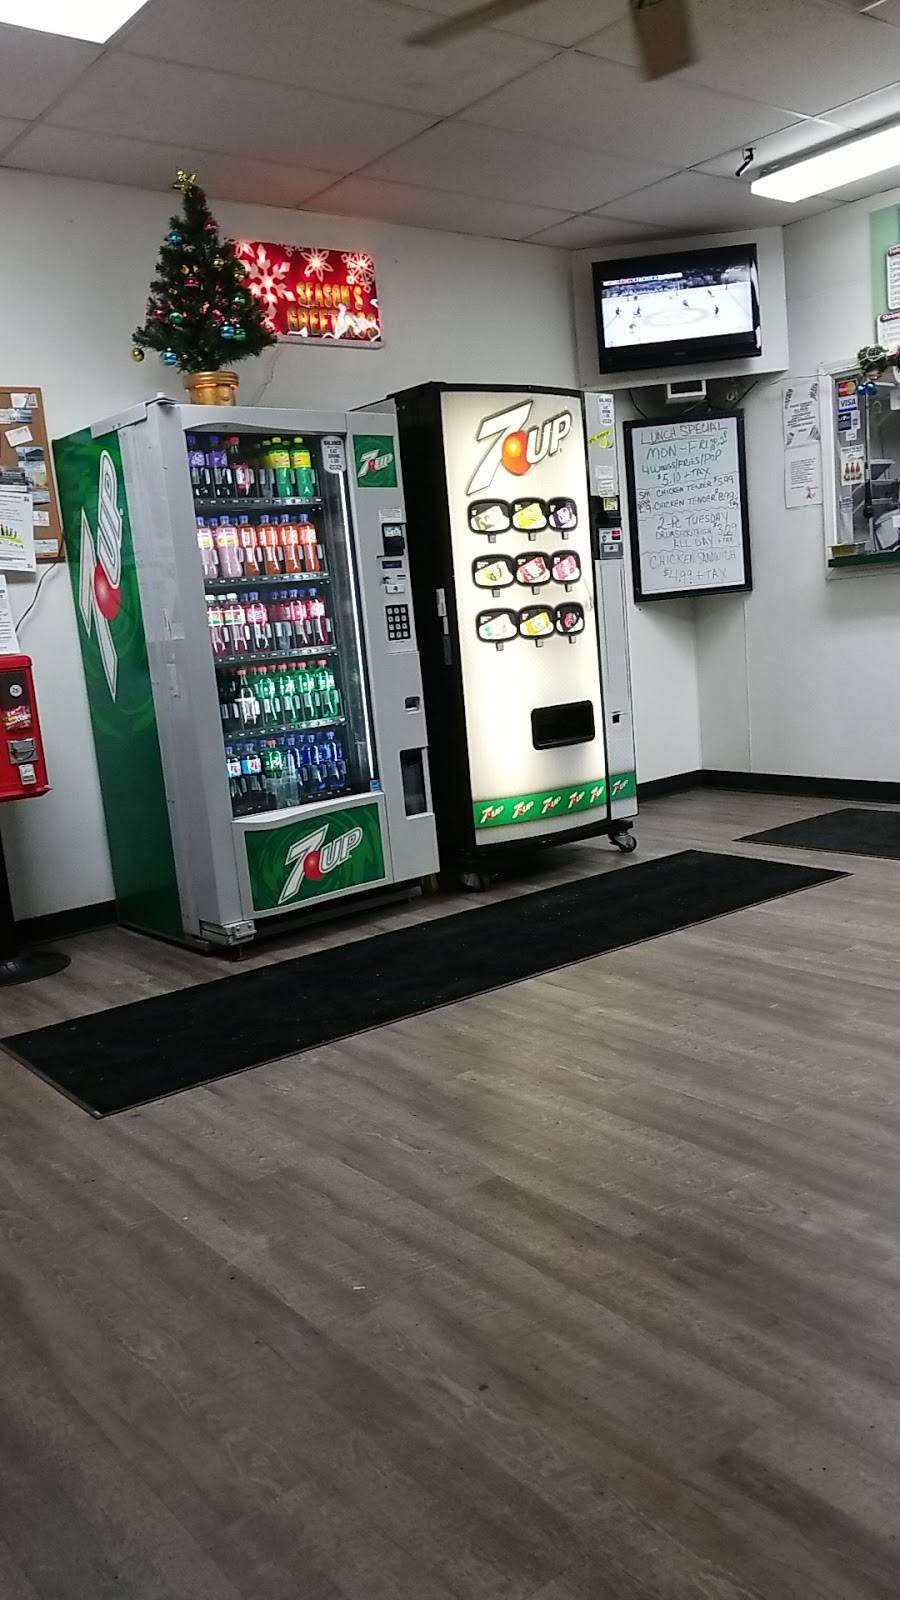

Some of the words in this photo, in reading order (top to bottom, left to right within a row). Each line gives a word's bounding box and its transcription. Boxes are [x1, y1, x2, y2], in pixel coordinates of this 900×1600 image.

[840, 398, 856, 407] VISA
[641, 427, 676, 445] LUNCH
[679, 422, 729, 437] SPECIAL
